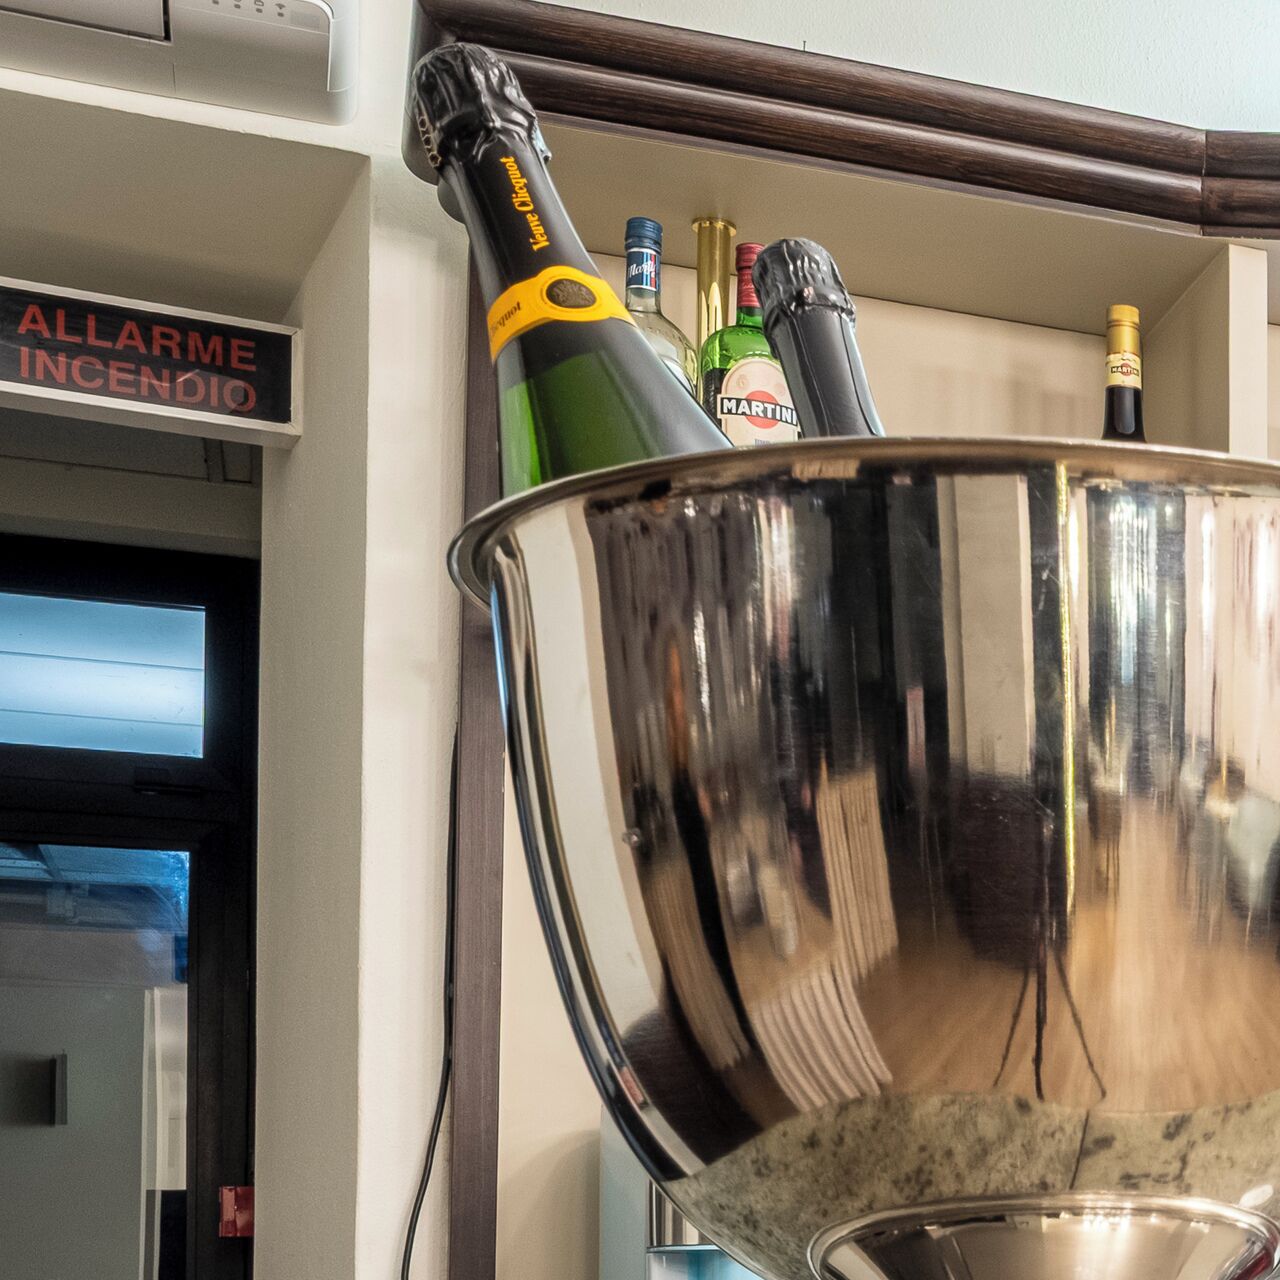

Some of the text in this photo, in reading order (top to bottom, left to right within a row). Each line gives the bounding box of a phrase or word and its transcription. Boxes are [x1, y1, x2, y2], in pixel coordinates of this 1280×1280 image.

[500, 156, 550, 251] Veuve Clicquot
[17, 303, 257, 371] ALLARME
[19, 346, 257, 412] INCENDIO
